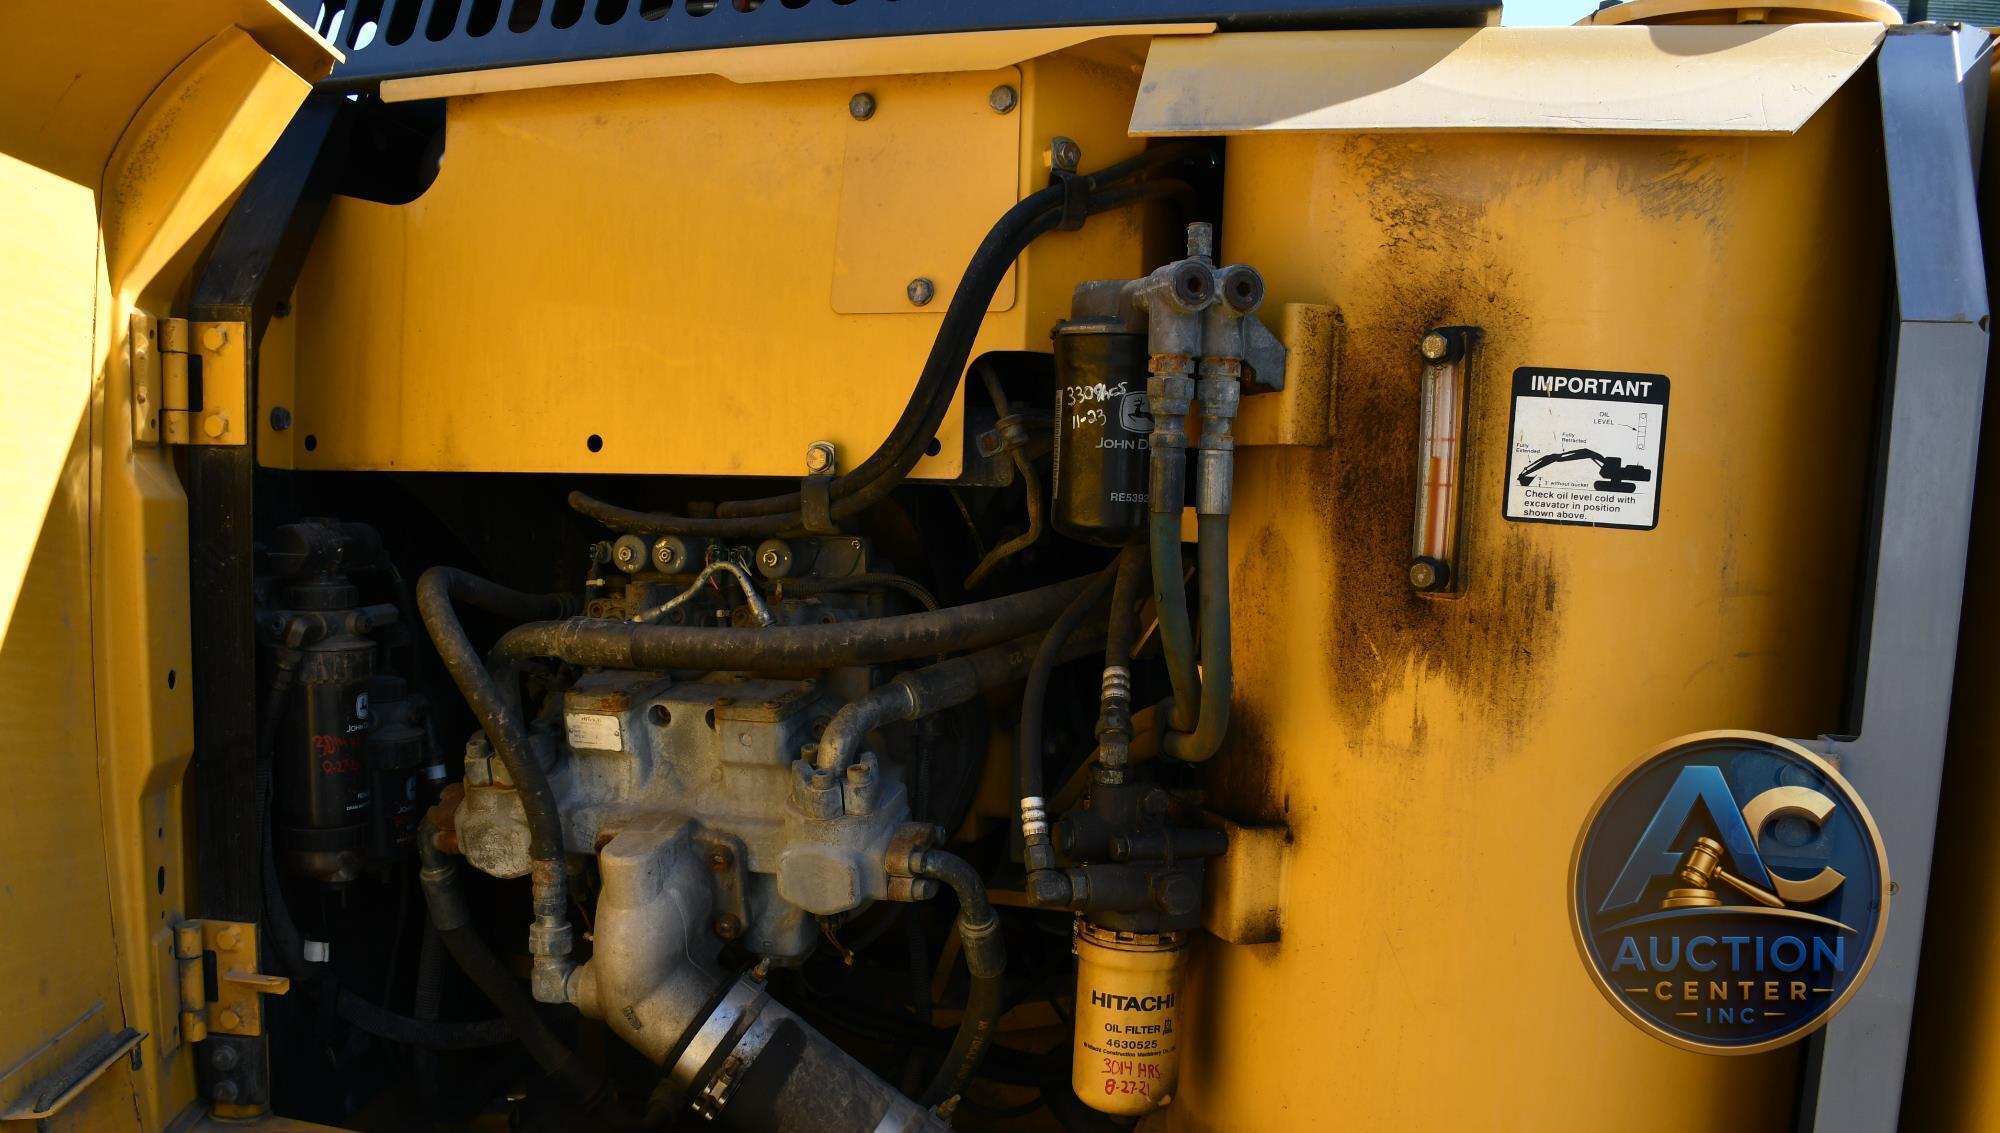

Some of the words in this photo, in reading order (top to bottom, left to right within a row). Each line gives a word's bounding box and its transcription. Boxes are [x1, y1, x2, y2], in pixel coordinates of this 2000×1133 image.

[1531, 375, 1652, 397] IMPORTANT
[1072, 408, 1107, 429] 11-23
[1095, 437, 1135, 450] JOHN
[1525, 490, 1554, 499] Check
[1556, 492, 1568, 500] oil
[1570, 493, 1592, 501] level
[1594, 494, 1615, 503] cold
[1617, 496, 1636, 504] with
[1524, 500, 1569, 509] excavator
[1583, 504, 1621, 513] position
[1523, 509, 1554, 517] shown
[1556, 511, 1587, 519] above.
[1092, 989, 1175, 1012] HITACHI
[1105, 1023, 1122, 1034] OIL
[1125, 1024, 1161, 1035] FILTER
[1106, 1038, 1158, 1050] 4630525
[1103, 1048, 1136, 1057] Construction
[1101, 1058, 1133, 1076] 3014
[1137, 1062, 1161, 1079] HRS
[1104, 1078, 1150, 1097] 8-27-21
